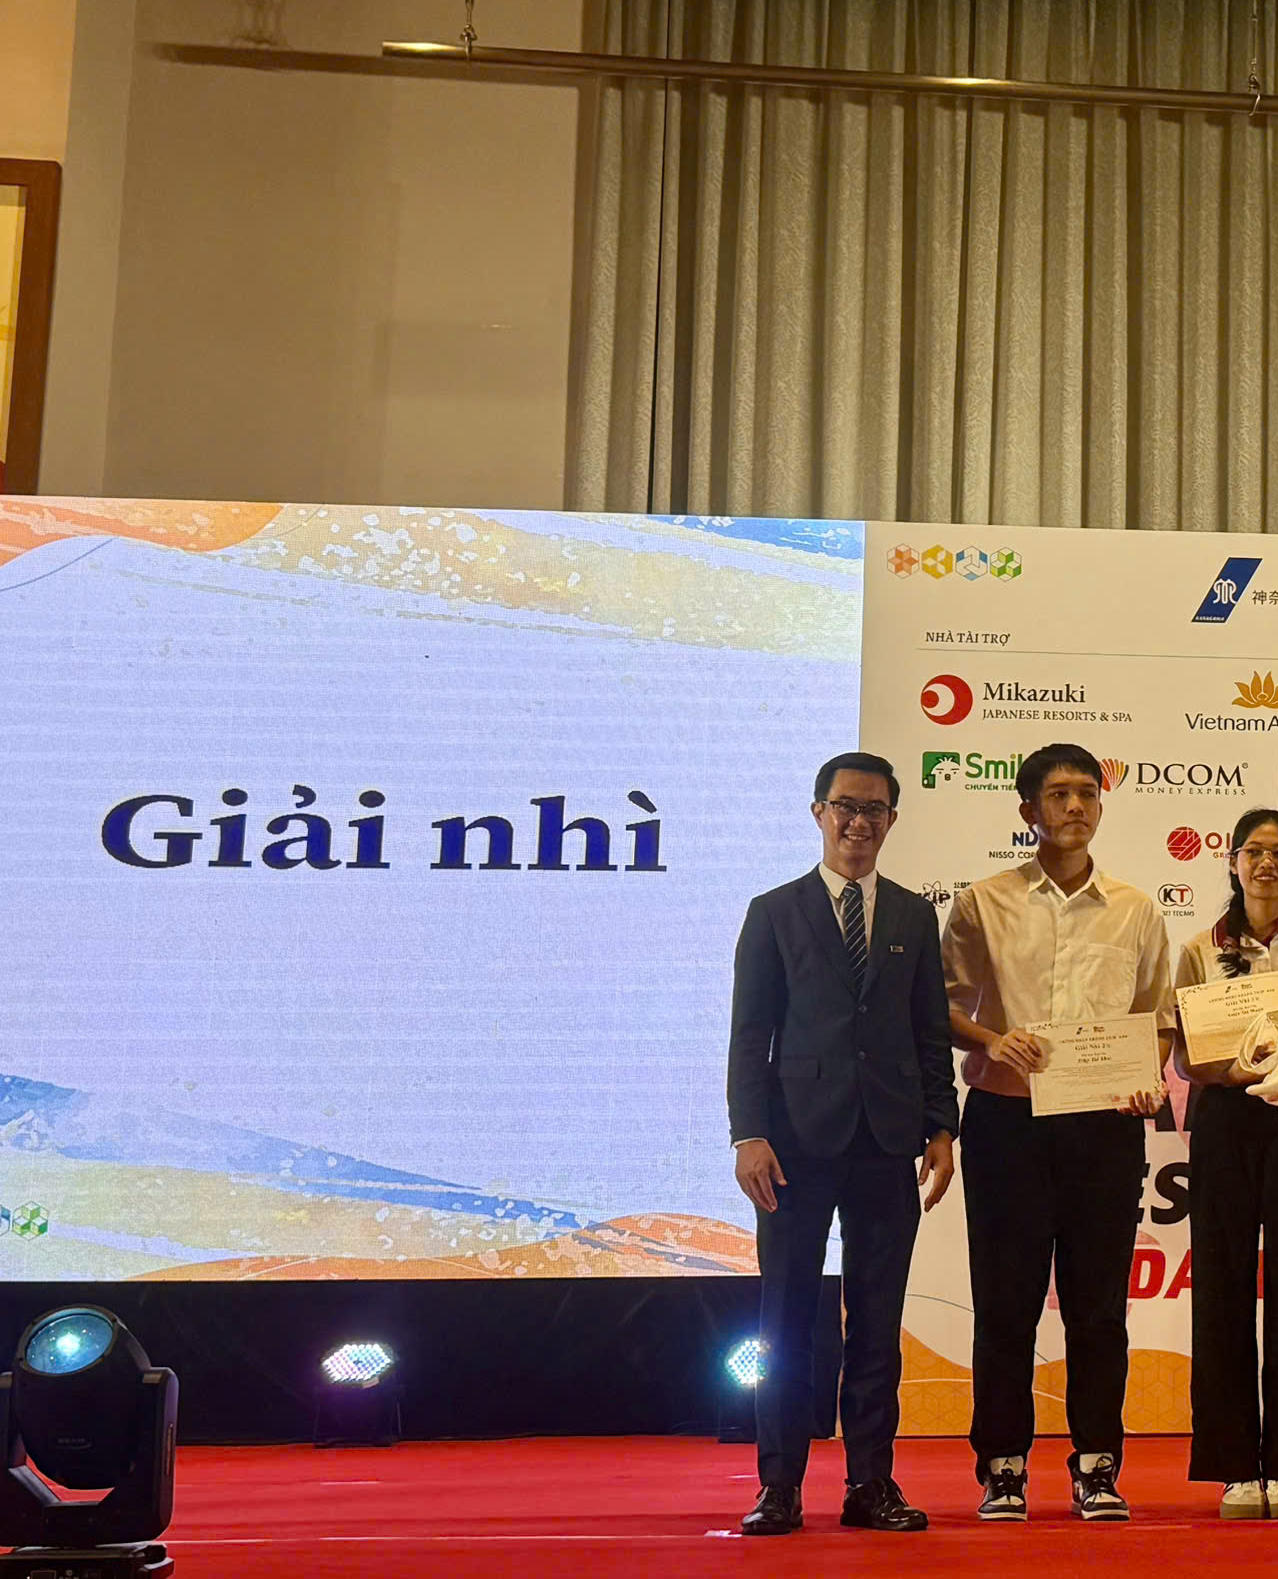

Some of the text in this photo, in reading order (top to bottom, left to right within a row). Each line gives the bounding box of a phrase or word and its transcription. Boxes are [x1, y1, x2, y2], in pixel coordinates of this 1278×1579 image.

[925, 629, 1011, 646] NHÀ TÀI TRỢ
[983, 682, 1086, 703] Mikazuki
[982, 709, 1133, 722] JAPANESE RESORTS & SPA
[1185, 713, 1265, 731] Vietnam
[965, 752, 1023, 780] Smil
[1136, 763, 1244, 787] DCOM
[1135, 787, 1246, 796] MONEY EXPRESS
[101, 784, 668, 872] Giải nhì
[988, 851, 1015, 859] NISSO
[1163, 888, 1189, 903] KT
